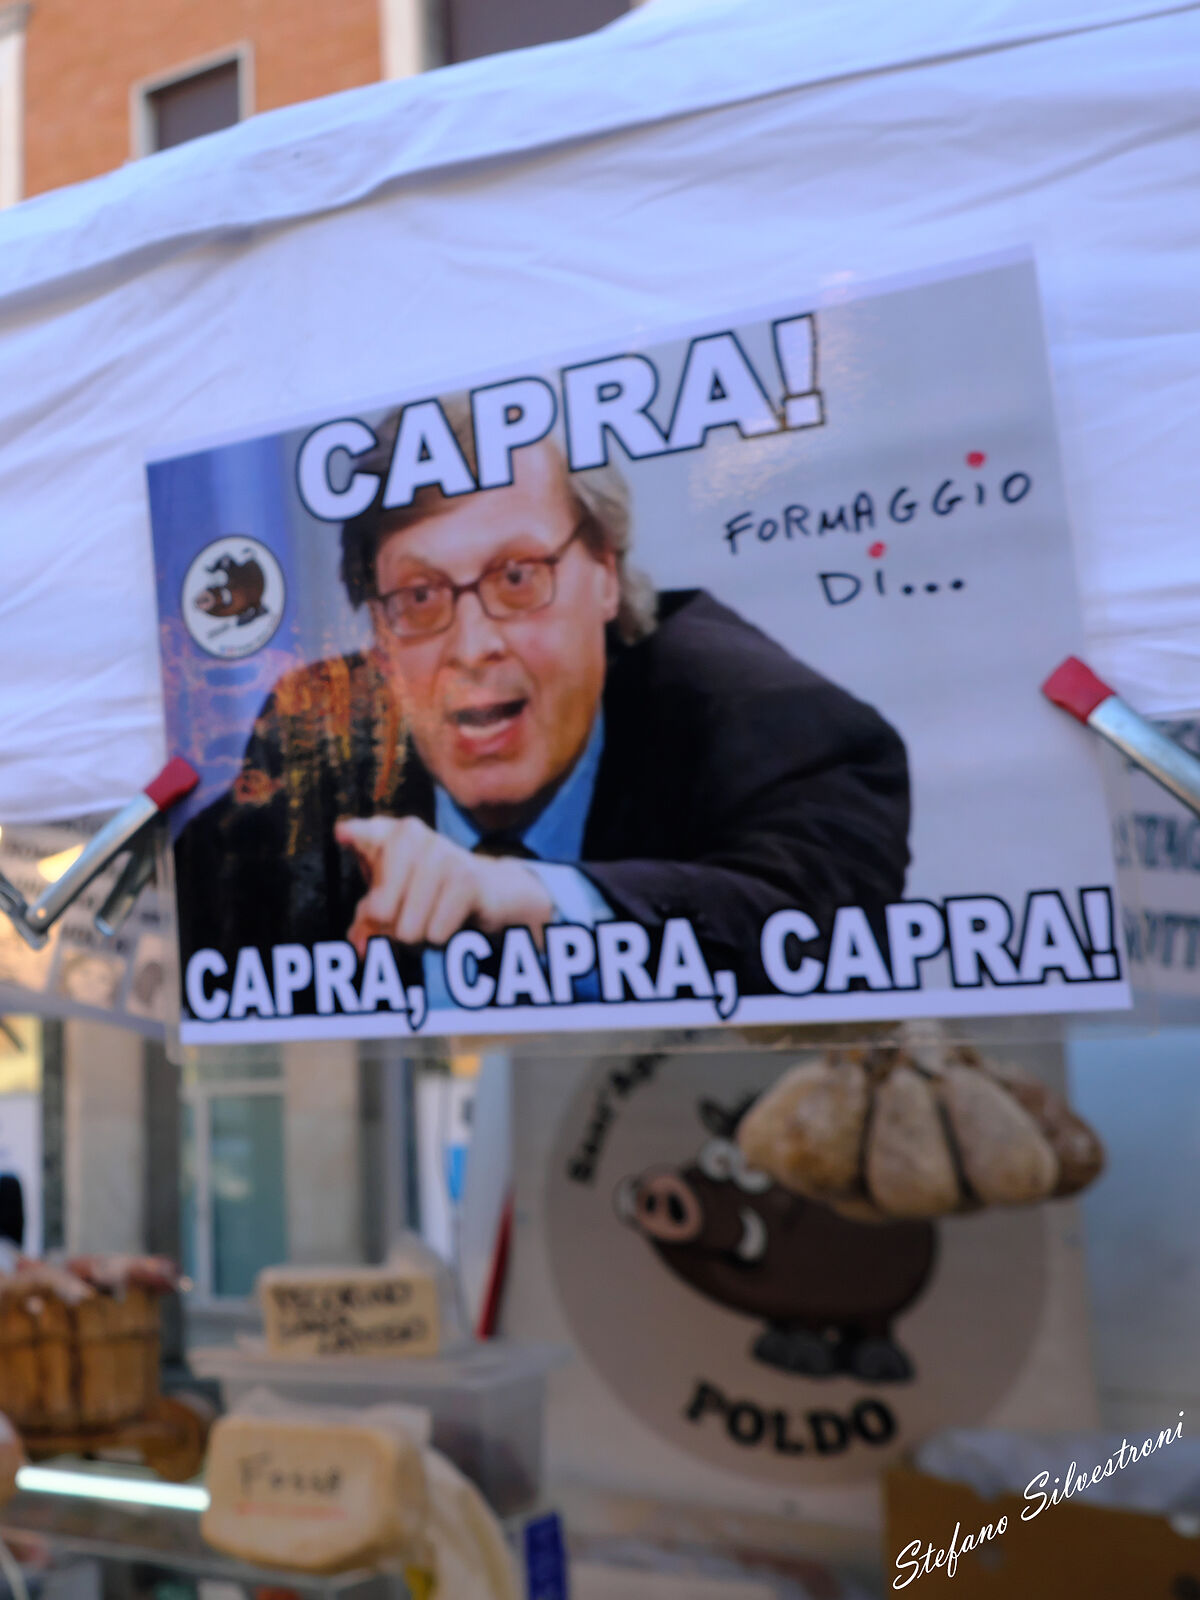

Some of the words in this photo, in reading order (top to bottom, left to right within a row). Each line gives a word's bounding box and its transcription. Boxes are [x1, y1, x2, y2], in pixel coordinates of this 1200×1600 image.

[296, 312, 826, 522] CAPRA!
[183, 936, 428, 1031] CAPRA,
[443, 916, 740, 1020] CAPRA,
[760, 886, 1122, 997] CAPRA!
[684, 1378, 898, 1457] POLDO
